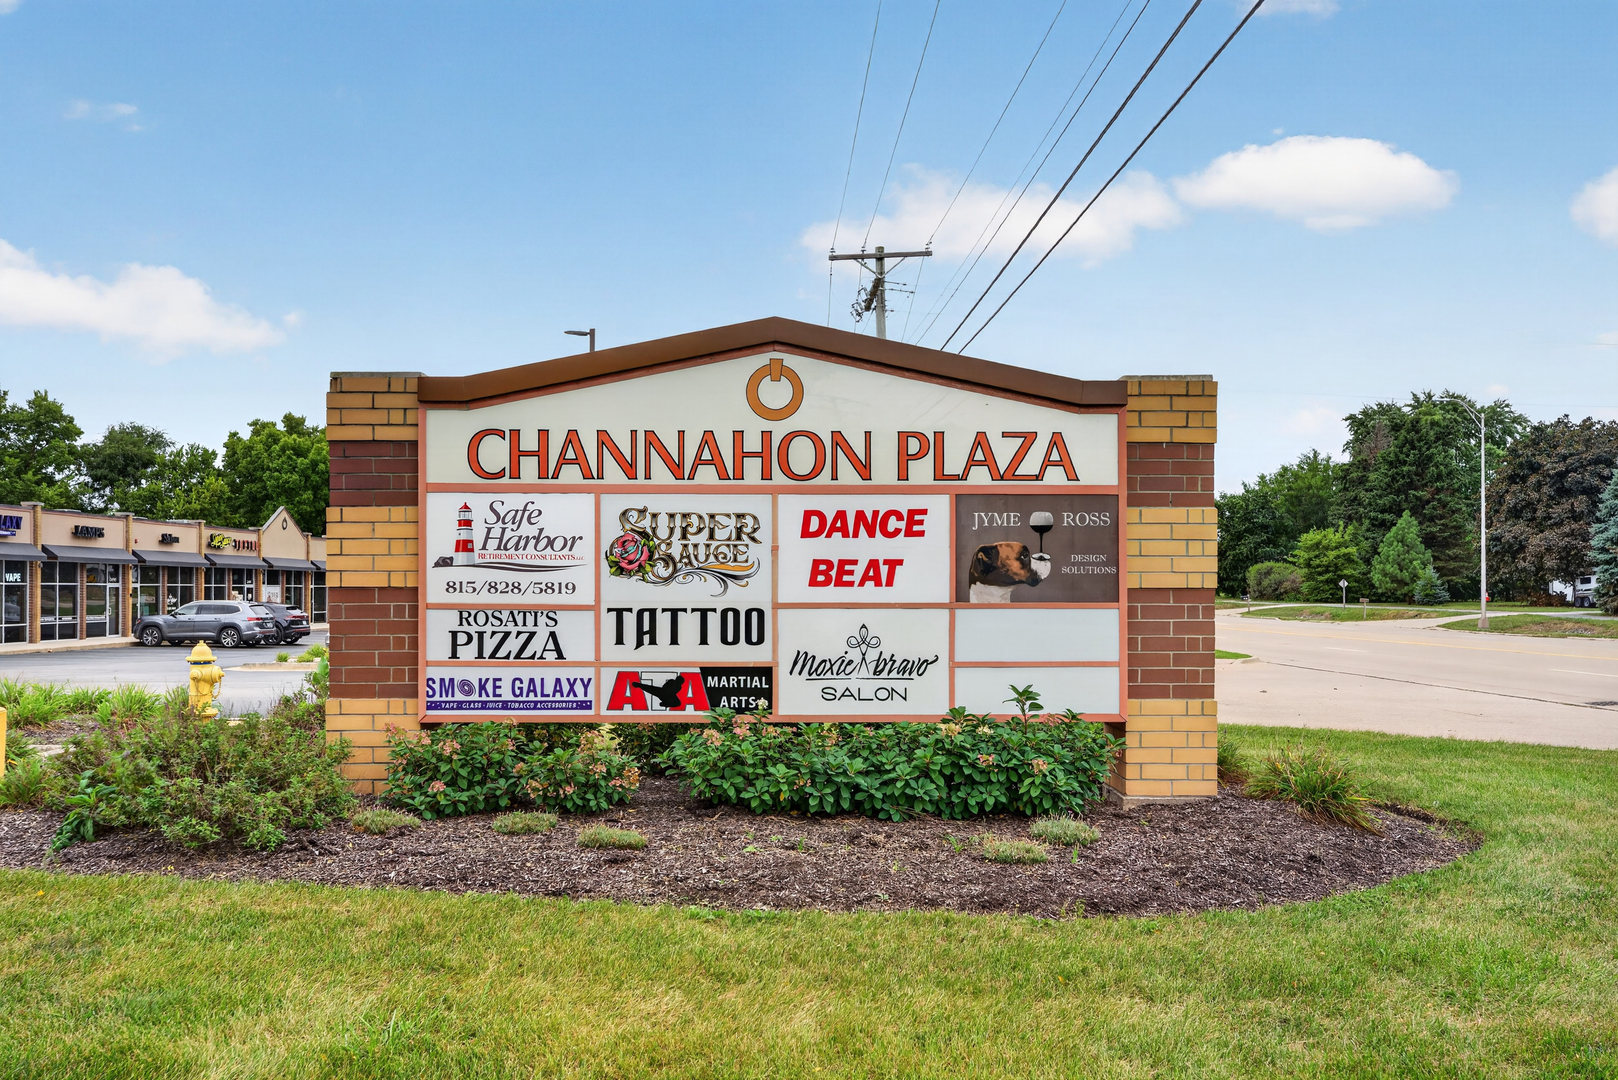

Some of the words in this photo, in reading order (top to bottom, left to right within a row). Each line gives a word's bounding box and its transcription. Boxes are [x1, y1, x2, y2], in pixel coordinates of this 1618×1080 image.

[467, 428, 872, 481] CHANNAHON
[897, 431, 1080, 482] PLAZA
[484, 500, 543, 532] Safe
[800, 508, 928, 539] DANCE
[972, 512, 1021, 531] JYME
[1061, 512, 1111, 527] ROSS
[479, 526, 583, 552] Harbor
[611, 505, 762, 556] SUPER
[478, 552, 525, 560] RETIREMENT
[525, 553, 575, 561] CONSULTANTS
[651, 540, 749, 581] SAUCE
[1070, 553, 1107, 563] DESIGN
[5, 573, 21, 582] VAPE
[808, 558, 904, 588] BEAT
[1061, 565, 1117, 575] SOLUTIONS
[445, 580, 576, 596] 815/828/5819
[457, 610, 558, 628] ROSATI'S
[607, 607, 766, 651] TATTOO
[448, 630, 567, 660] PIZZA
[789, 650, 860, 677] Moxie
[868, 650, 939, 677] bravo
[511, 677, 593, 698] GALAXY
[606, 671, 711, 711] ATA
[707, 676, 769, 688] MARTIAL
[719, 696, 756, 709] ARTS
[821, 687, 907, 702] SALON
